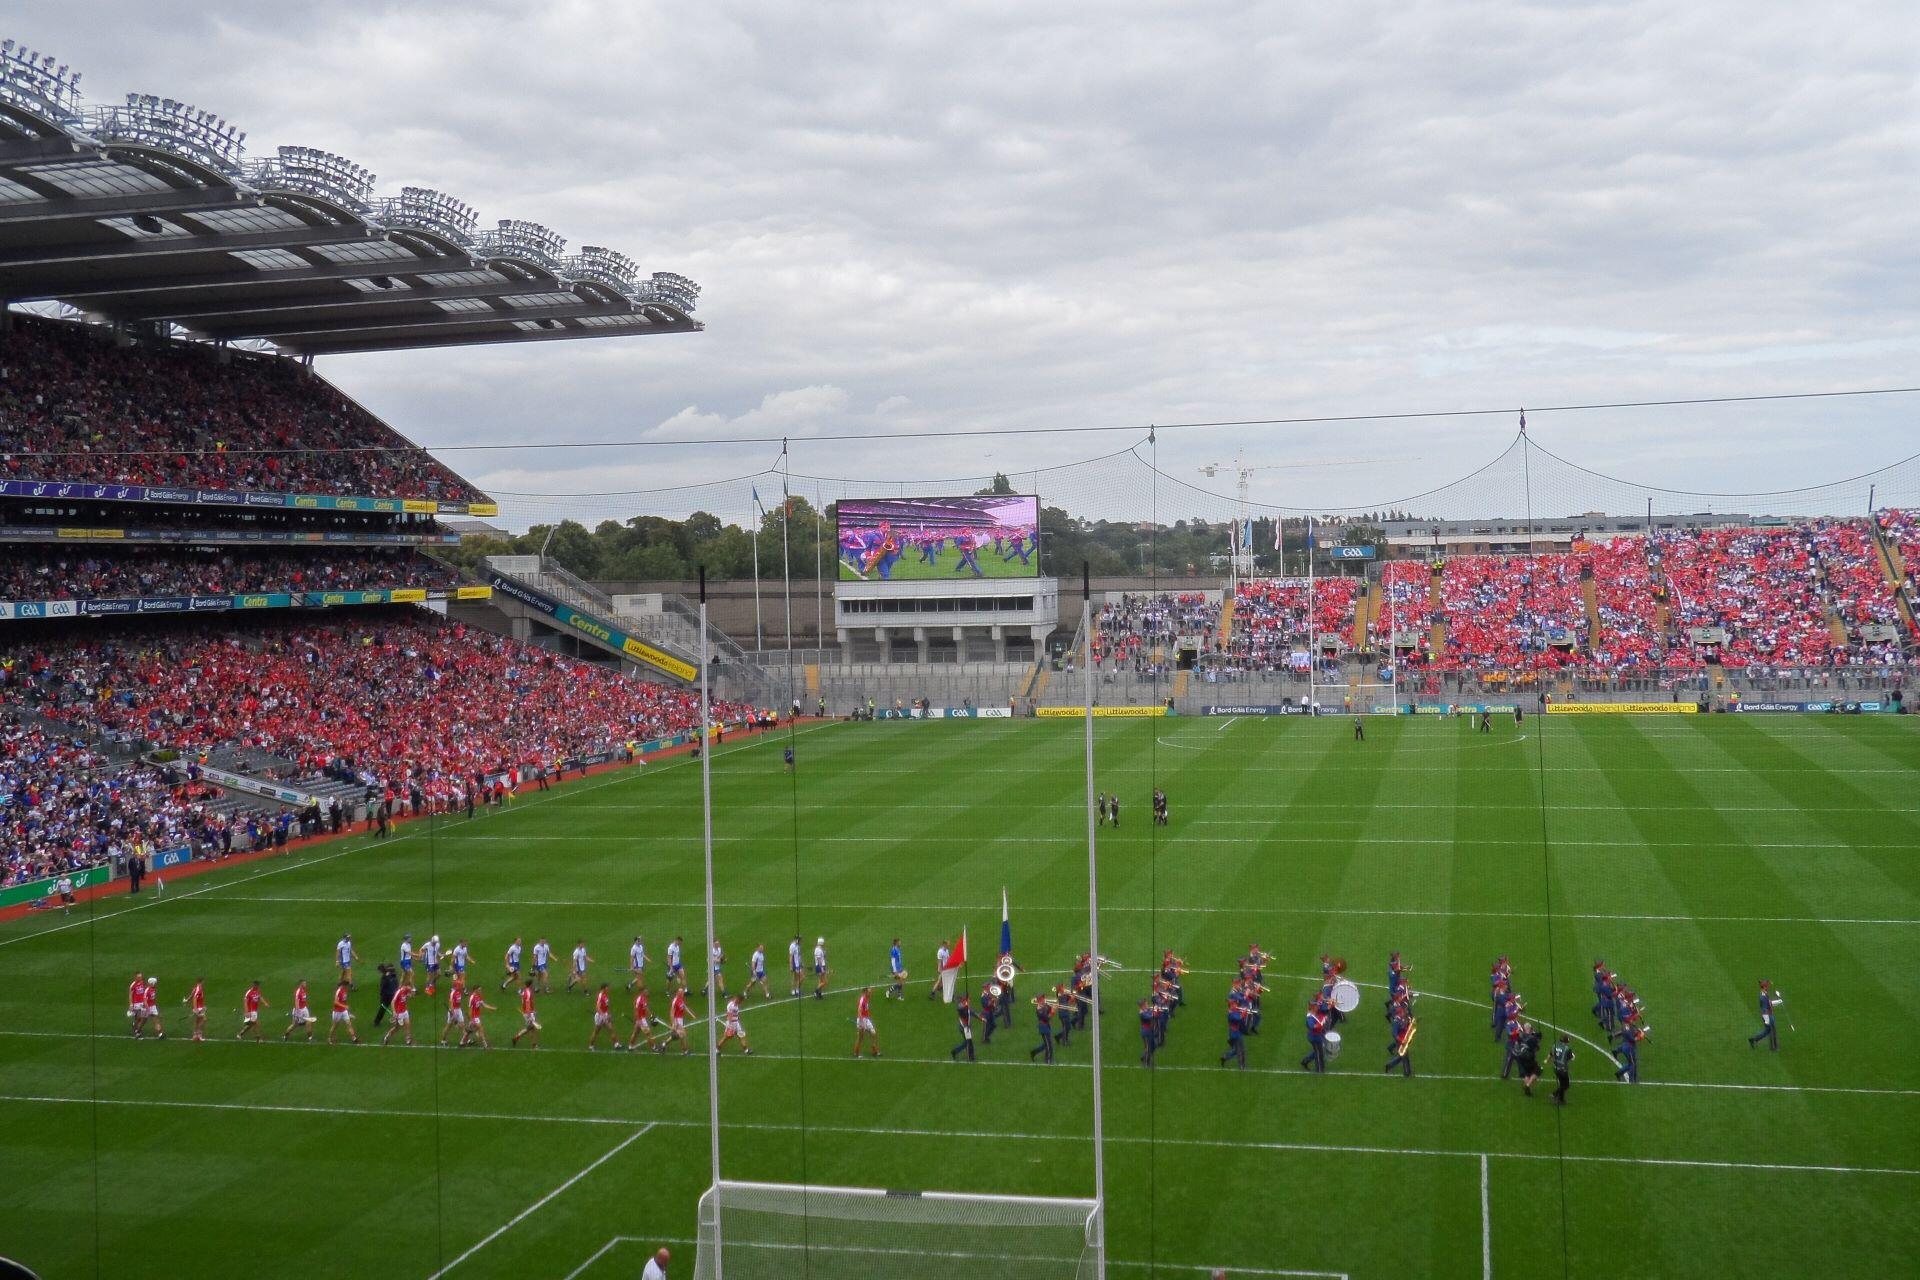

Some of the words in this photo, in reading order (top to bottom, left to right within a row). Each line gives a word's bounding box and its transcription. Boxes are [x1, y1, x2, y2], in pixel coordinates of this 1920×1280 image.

[0, 481, 8, 492] ir
[33, 482, 47, 496] eir
[58, 484, 72, 497] eir
[94, 486, 106, 498] eir
[117, 487, 129, 499] eir
[243, 596, 268, 607] Centra
[502, 582, 517, 596] Bord
[531, 597, 554, 613] Energy
[569, 614, 610, 641] Centra
[627, 642, 668, 666] Littlewoods
[1038, 708, 1079, 716] Littlewoods
[1106, 708, 1148, 716] Littlewoods
[1623, 704, 1669, 712] Littlewoods
[1669, 704, 1695, 712] Ireland
[1775, 704, 1798, 712] Energy
[76, 873, 89, 888] eir
